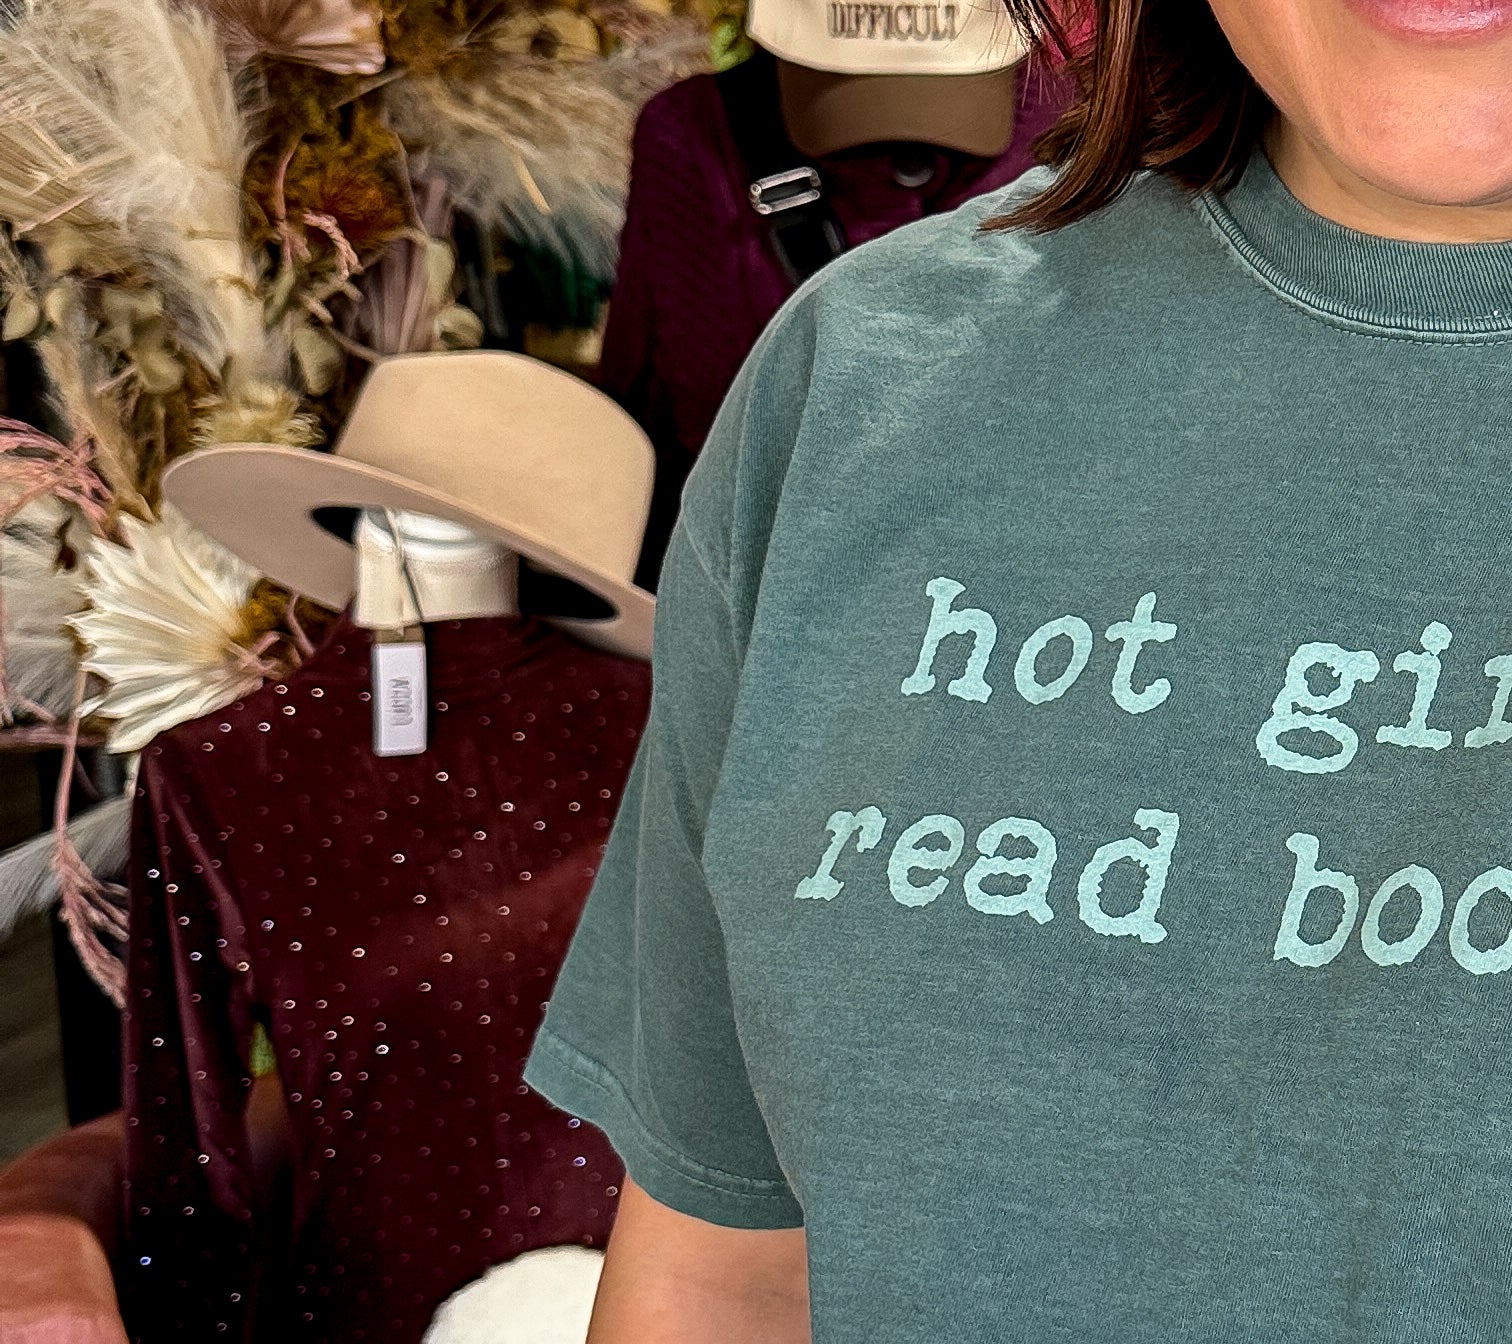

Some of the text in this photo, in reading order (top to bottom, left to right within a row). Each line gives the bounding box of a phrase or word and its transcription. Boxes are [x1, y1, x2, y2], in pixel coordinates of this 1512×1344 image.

[830, 2, 958, 40] DIFFICULT
[901, 577, 1177, 714] hot
[795, 806, 1179, 943] read
